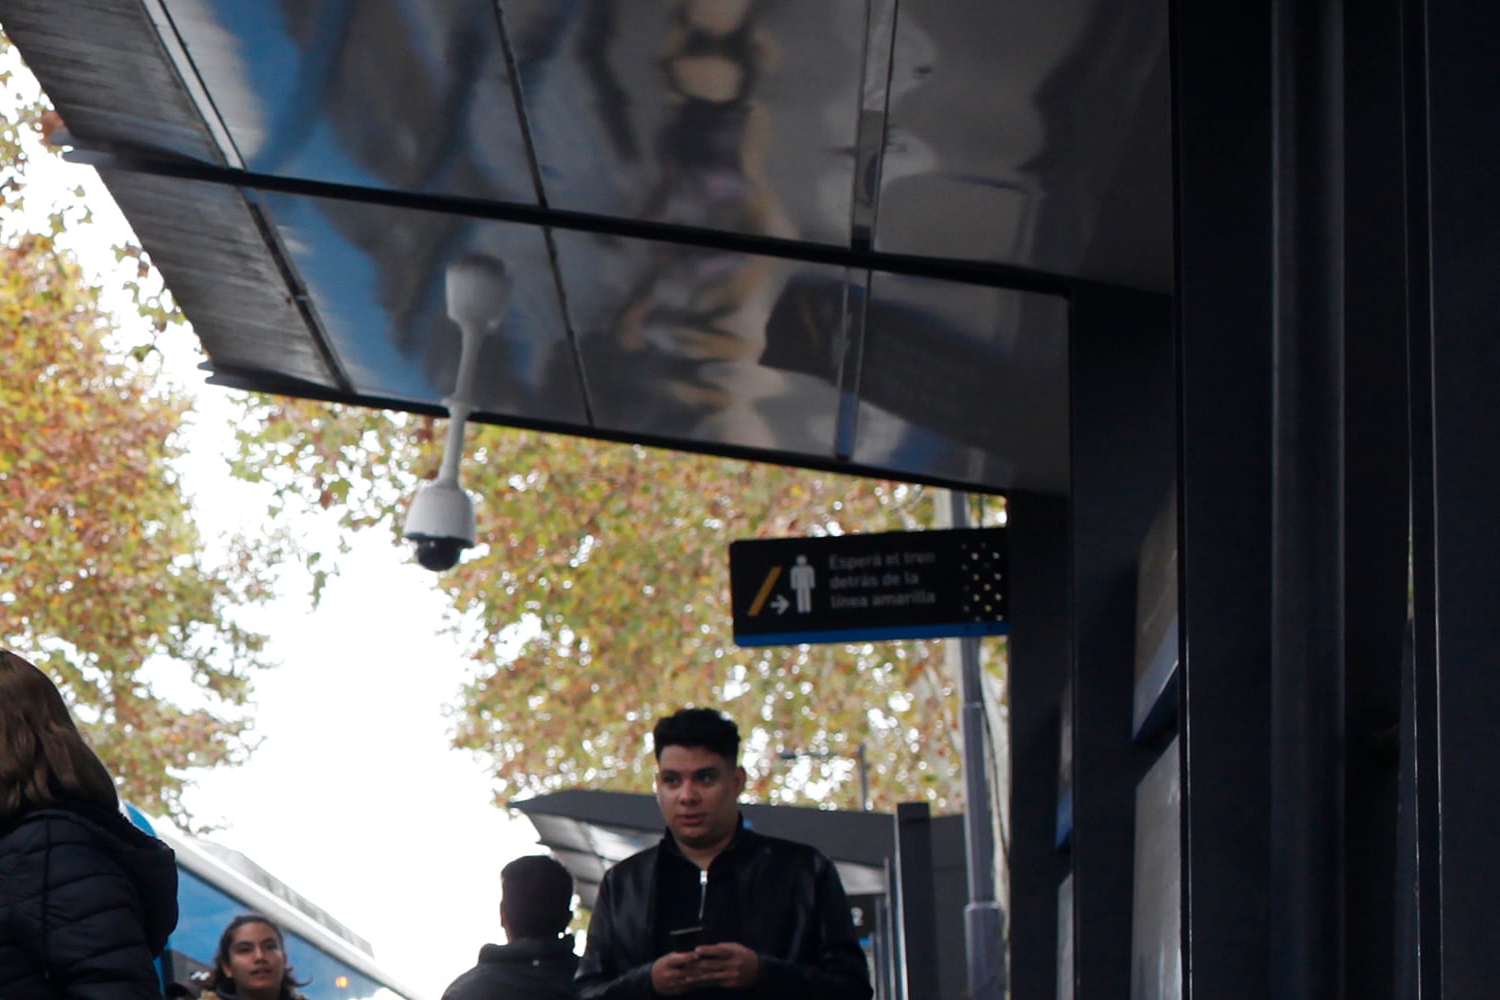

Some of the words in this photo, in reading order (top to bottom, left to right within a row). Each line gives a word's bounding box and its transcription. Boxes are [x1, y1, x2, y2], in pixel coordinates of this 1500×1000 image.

[885, 552, 900, 565] el
[903, 551, 936, 565] tren
[882, 571, 901, 586] de
[904, 570, 920, 585] la
[871, 589, 937, 607] amarilla
